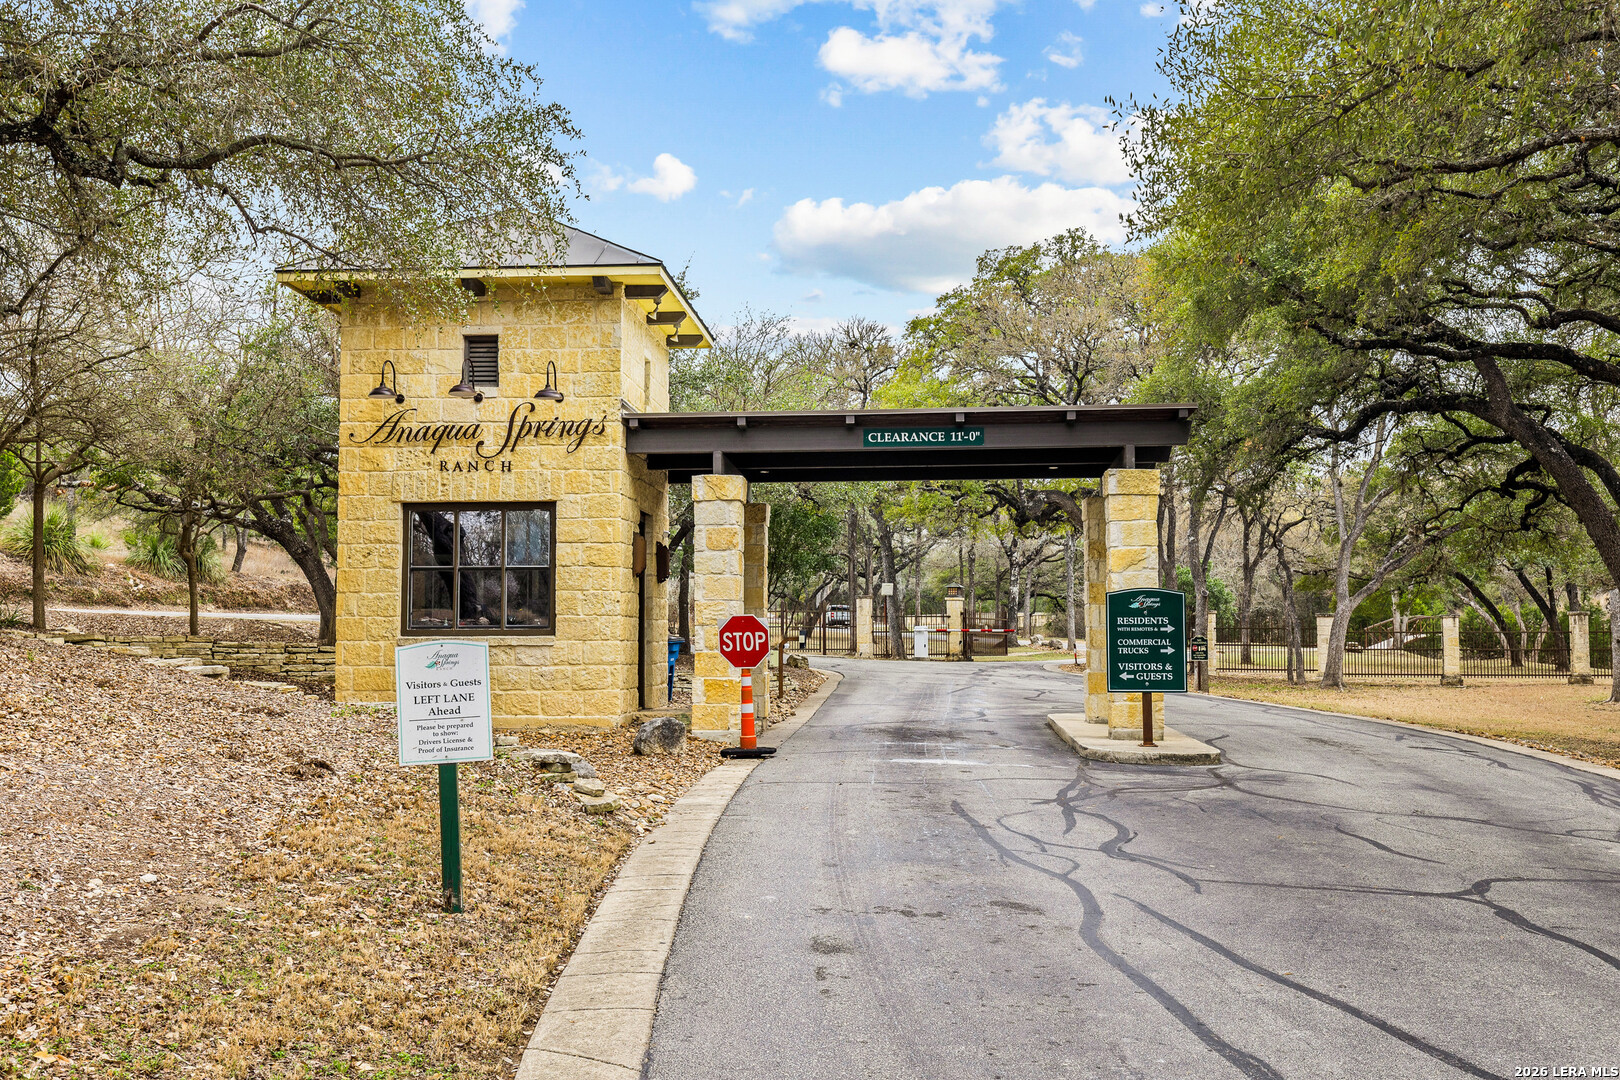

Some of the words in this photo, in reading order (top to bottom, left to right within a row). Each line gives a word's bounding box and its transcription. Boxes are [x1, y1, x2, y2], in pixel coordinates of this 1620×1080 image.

[349, 408, 484, 454] Anaqua
[475, 402, 608, 459] Springs
[868, 431, 945, 442] CLEARANCE
[950, 431, 980, 442] 11'-0"
[439, 460, 513, 473] RANCH
[1117, 616, 1169, 625] RESIDENTS
[722, 631, 766, 652] STOP
[1117, 638, 1171, 646] COMMERCIAL
[427, 649, 459, 661] Anaqua
[1117, 662, 1163, 671] VISITORS
[1165, 663, 1173, 671] &
[1136, 672, 1173, 681] GUESTS
[406, 681, 442, 690] Visitors
[450, 679, 482, 688] Guests
[414, 694, 441, 705] LEFT
[444, 692, 475, 703] LANE
[428, 705, 461, 716] Ahead
[446, 722, 474, 731] prepared
